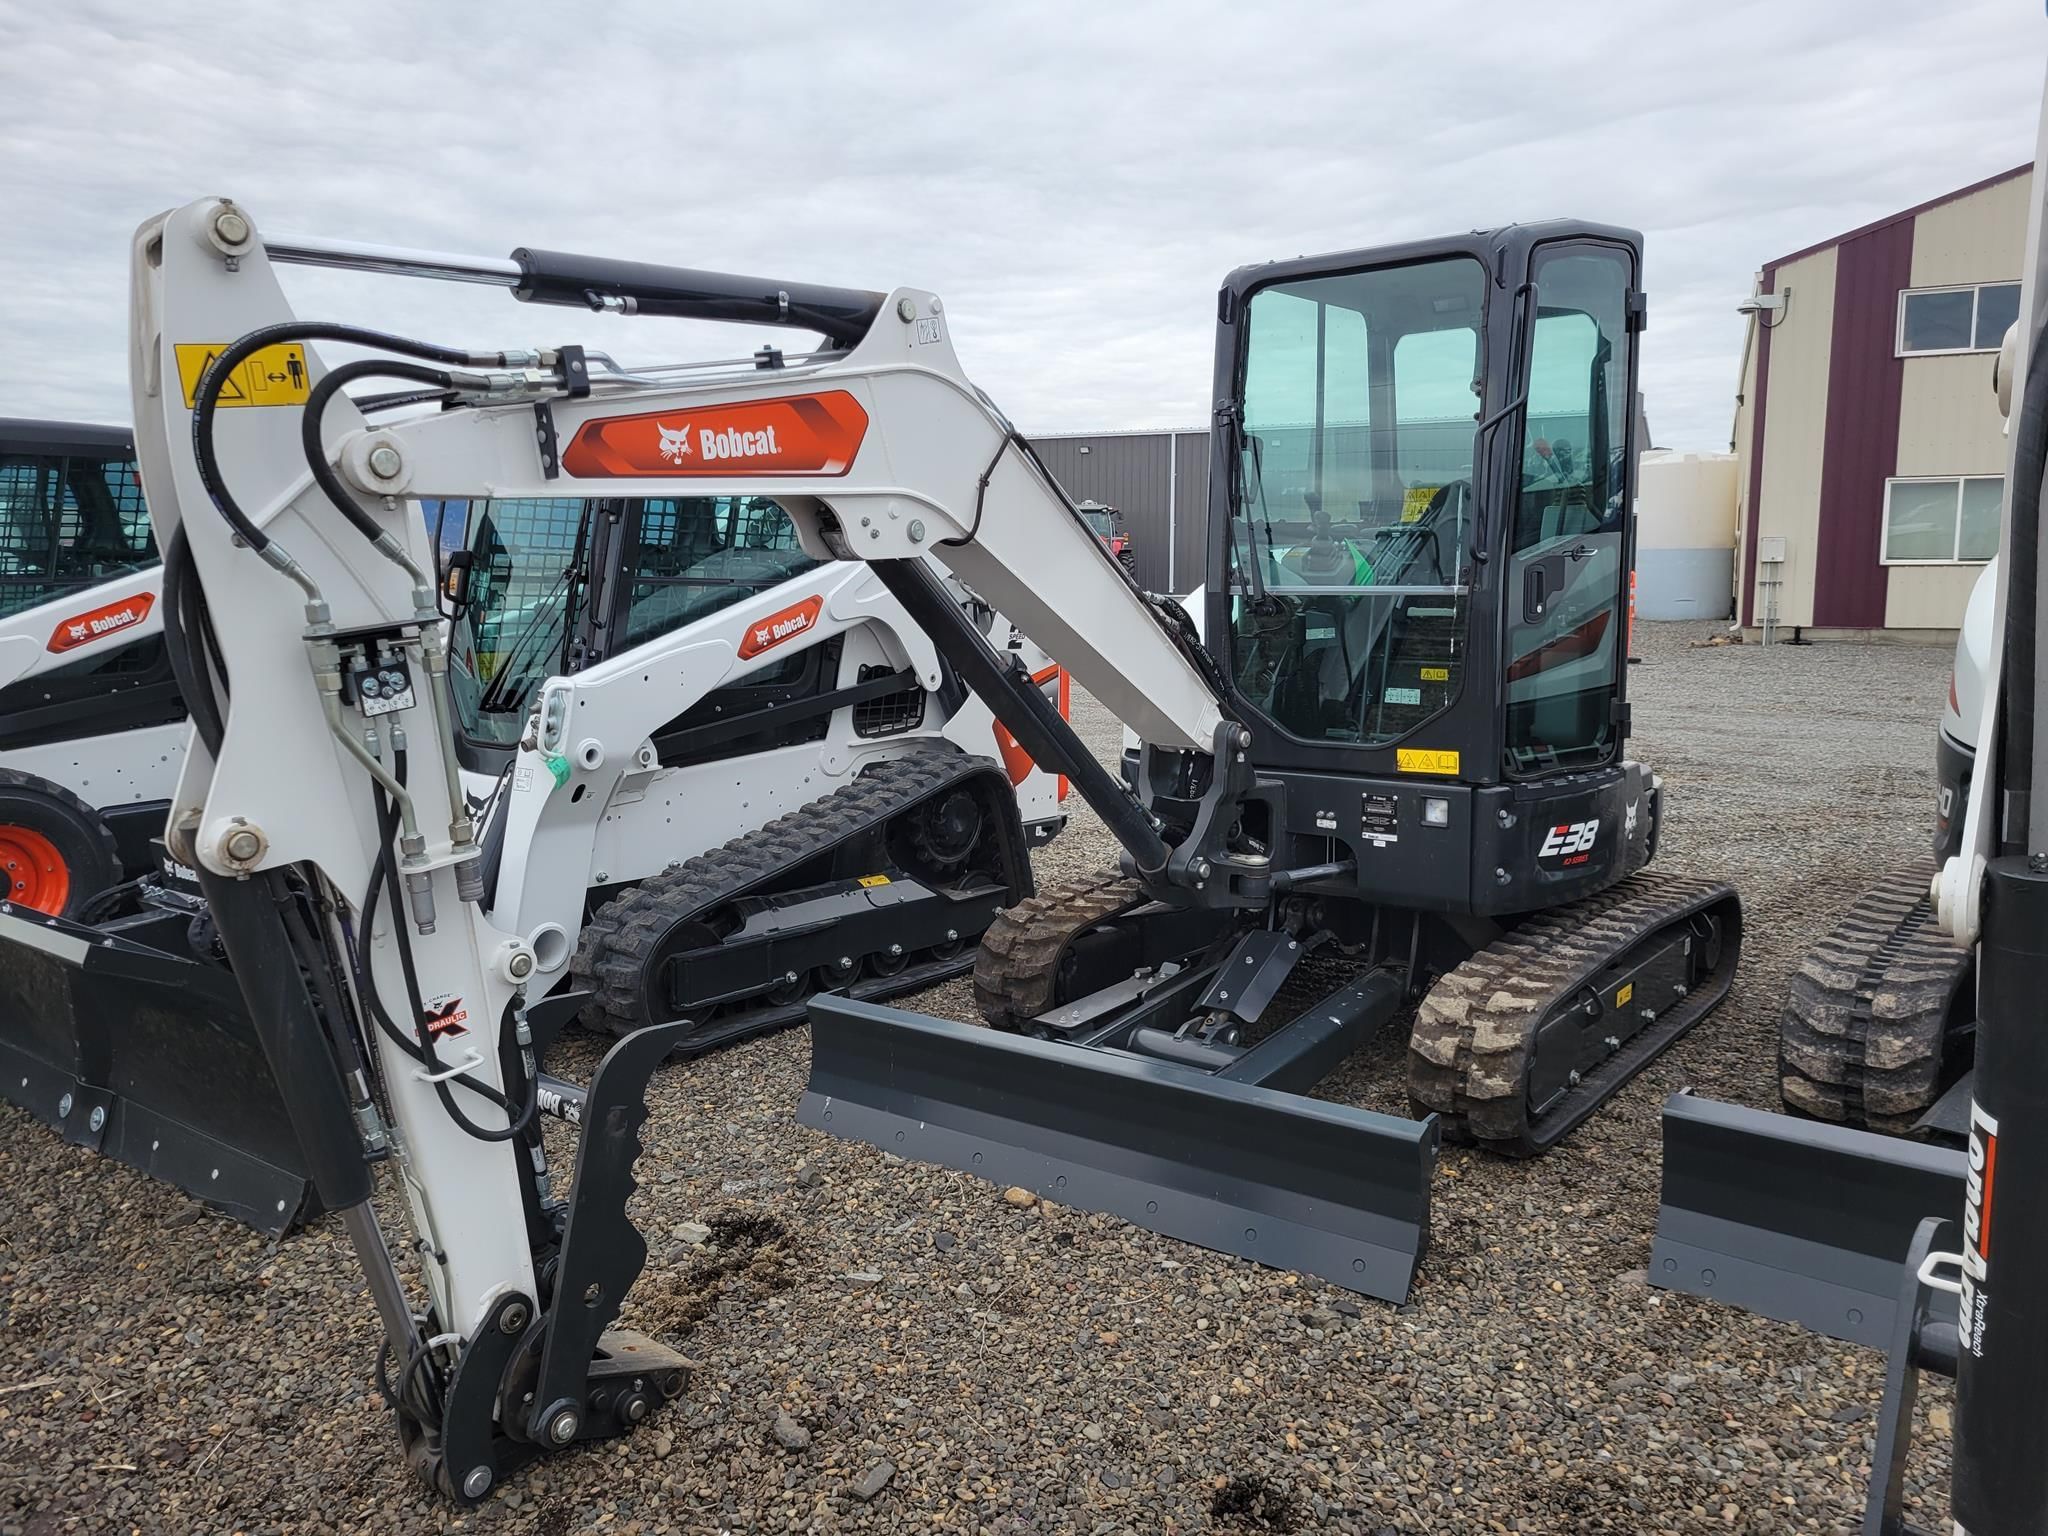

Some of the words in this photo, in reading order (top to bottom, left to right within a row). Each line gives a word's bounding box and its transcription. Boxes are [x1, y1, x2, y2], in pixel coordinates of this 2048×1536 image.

[699, 425, 778, 461] Bobcat
[90, 608, 135, 634] Bobcat
[772, 613, 808, 640] Bobcat
[1537, 818, 1600, 858] E38
[1972, 1288, 1989, 1358] XtraReach
